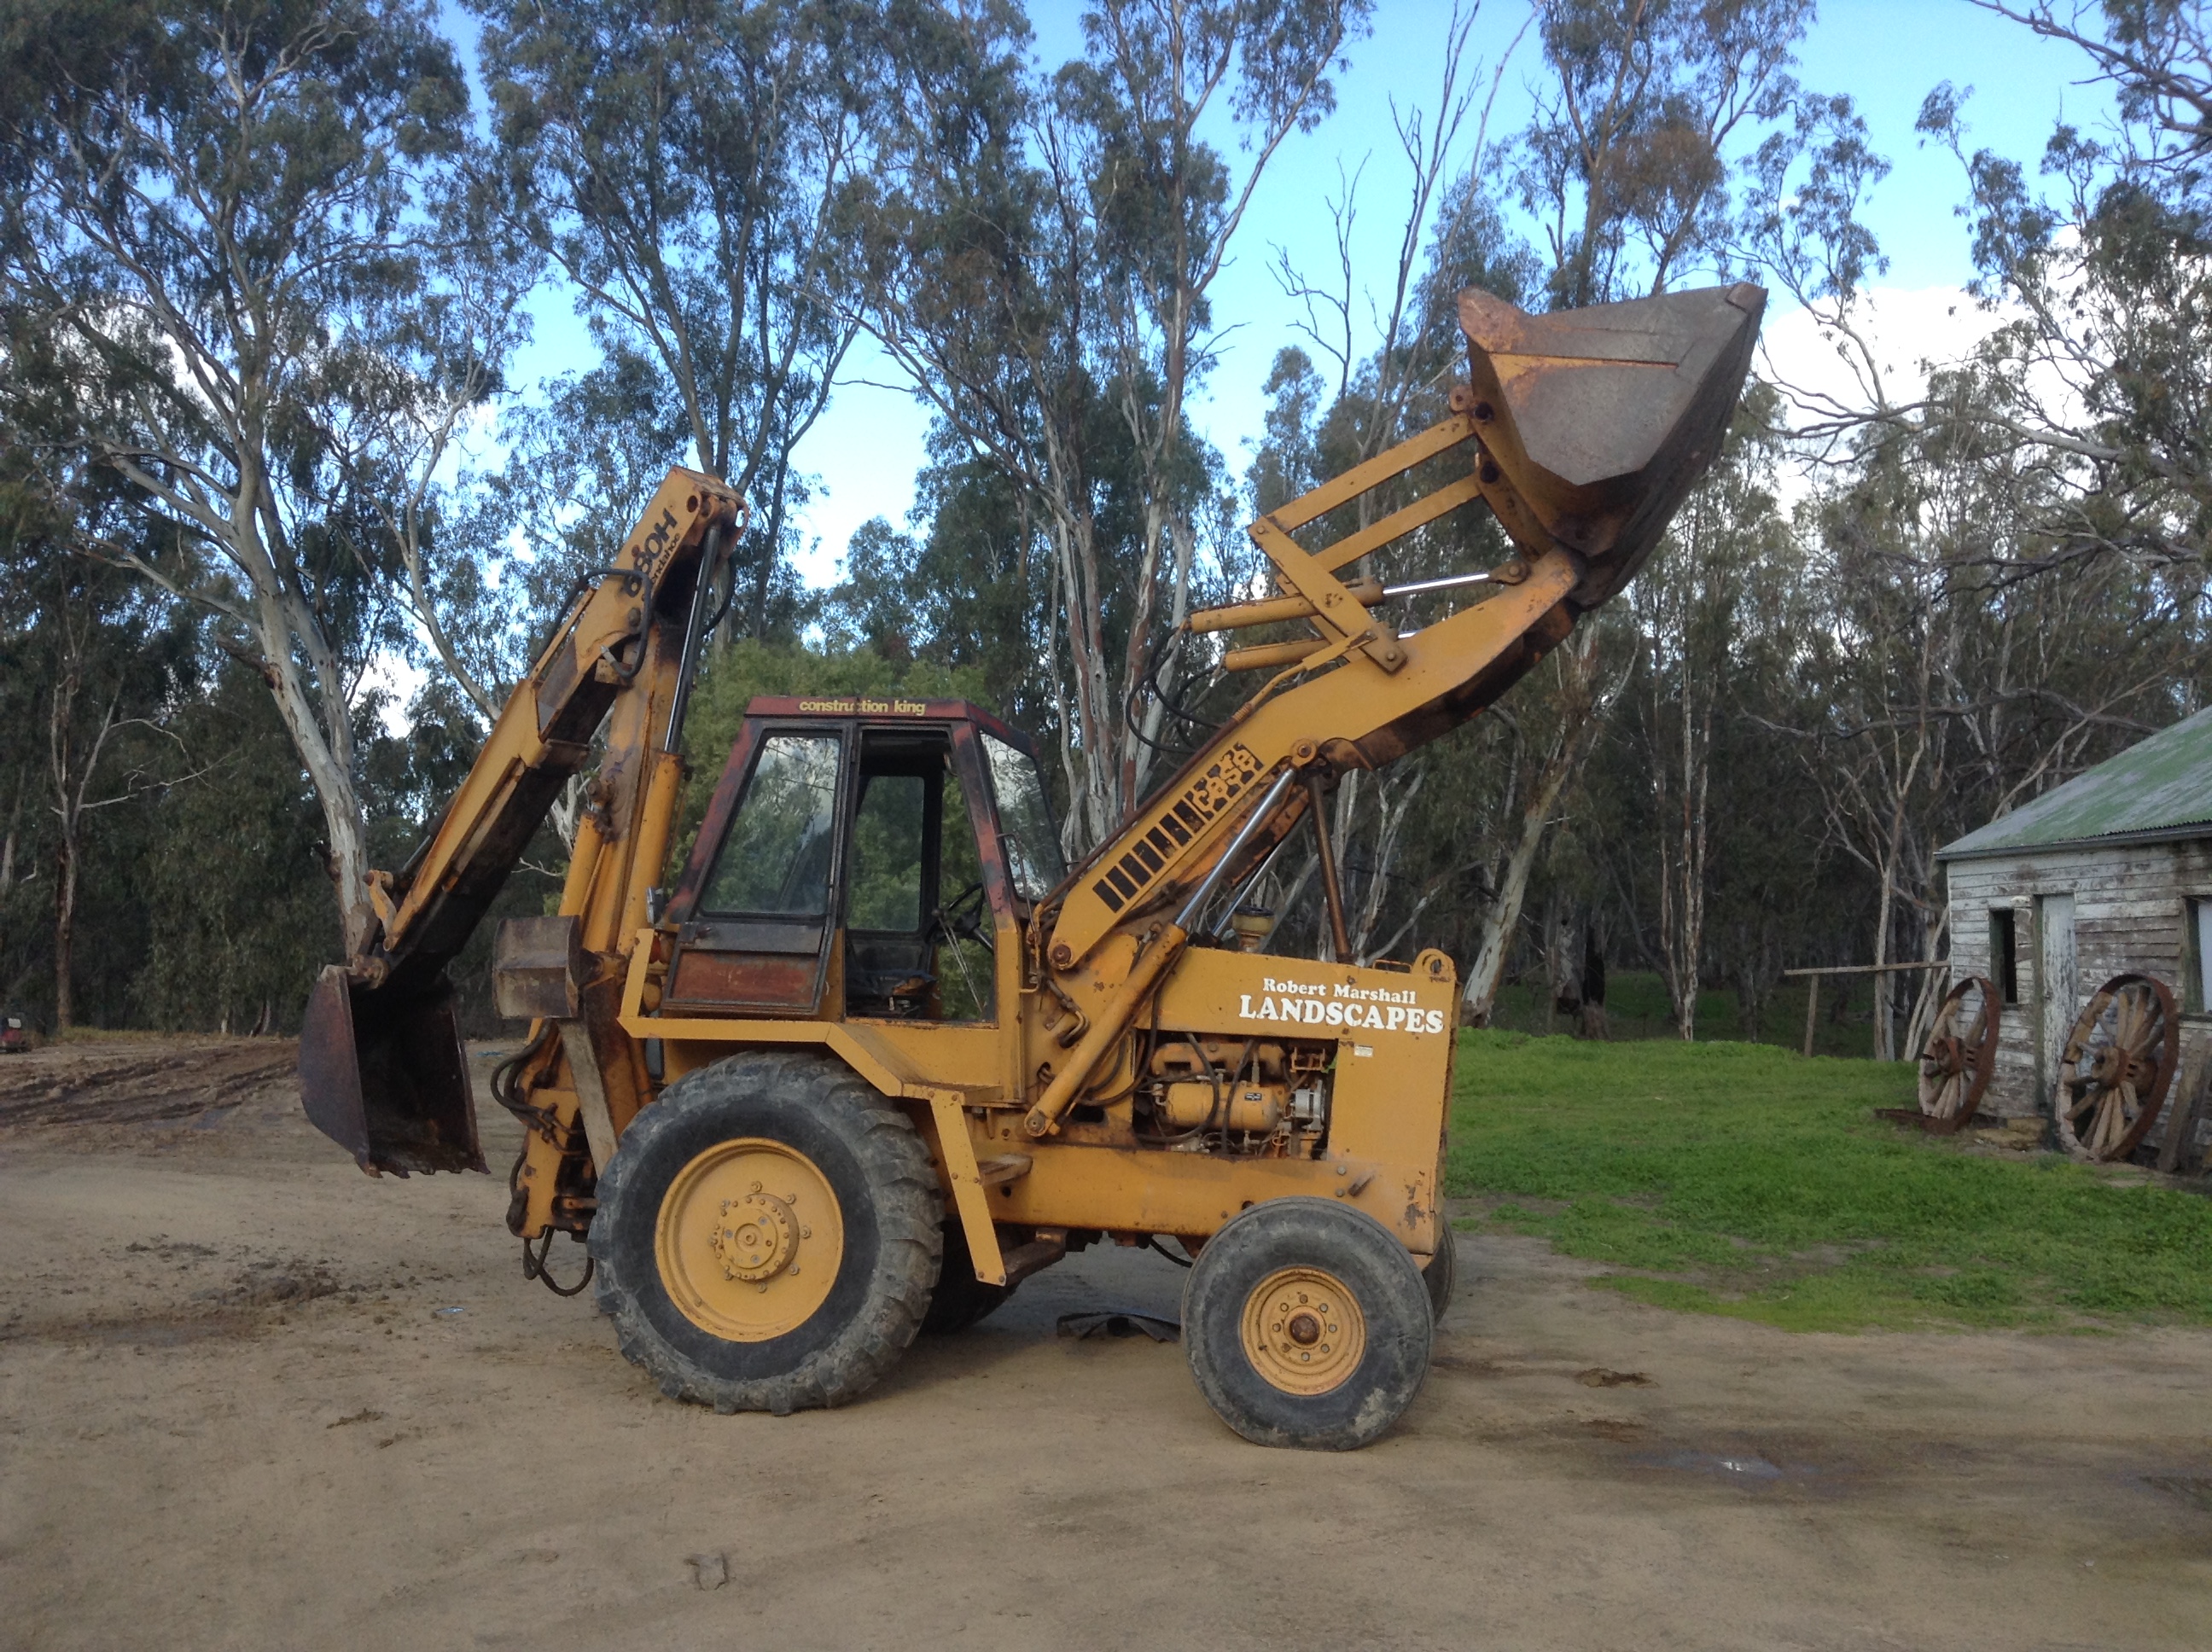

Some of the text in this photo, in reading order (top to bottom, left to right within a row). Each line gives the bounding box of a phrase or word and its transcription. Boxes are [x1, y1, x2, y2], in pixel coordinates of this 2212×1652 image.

[623, 508, 678, 597] 680H
[894, 700, 926, 716] king
[1263, 978, 1417, 1005] Robert Marshall
[1238, 994, 1445, 1034] LANDSCAPES
